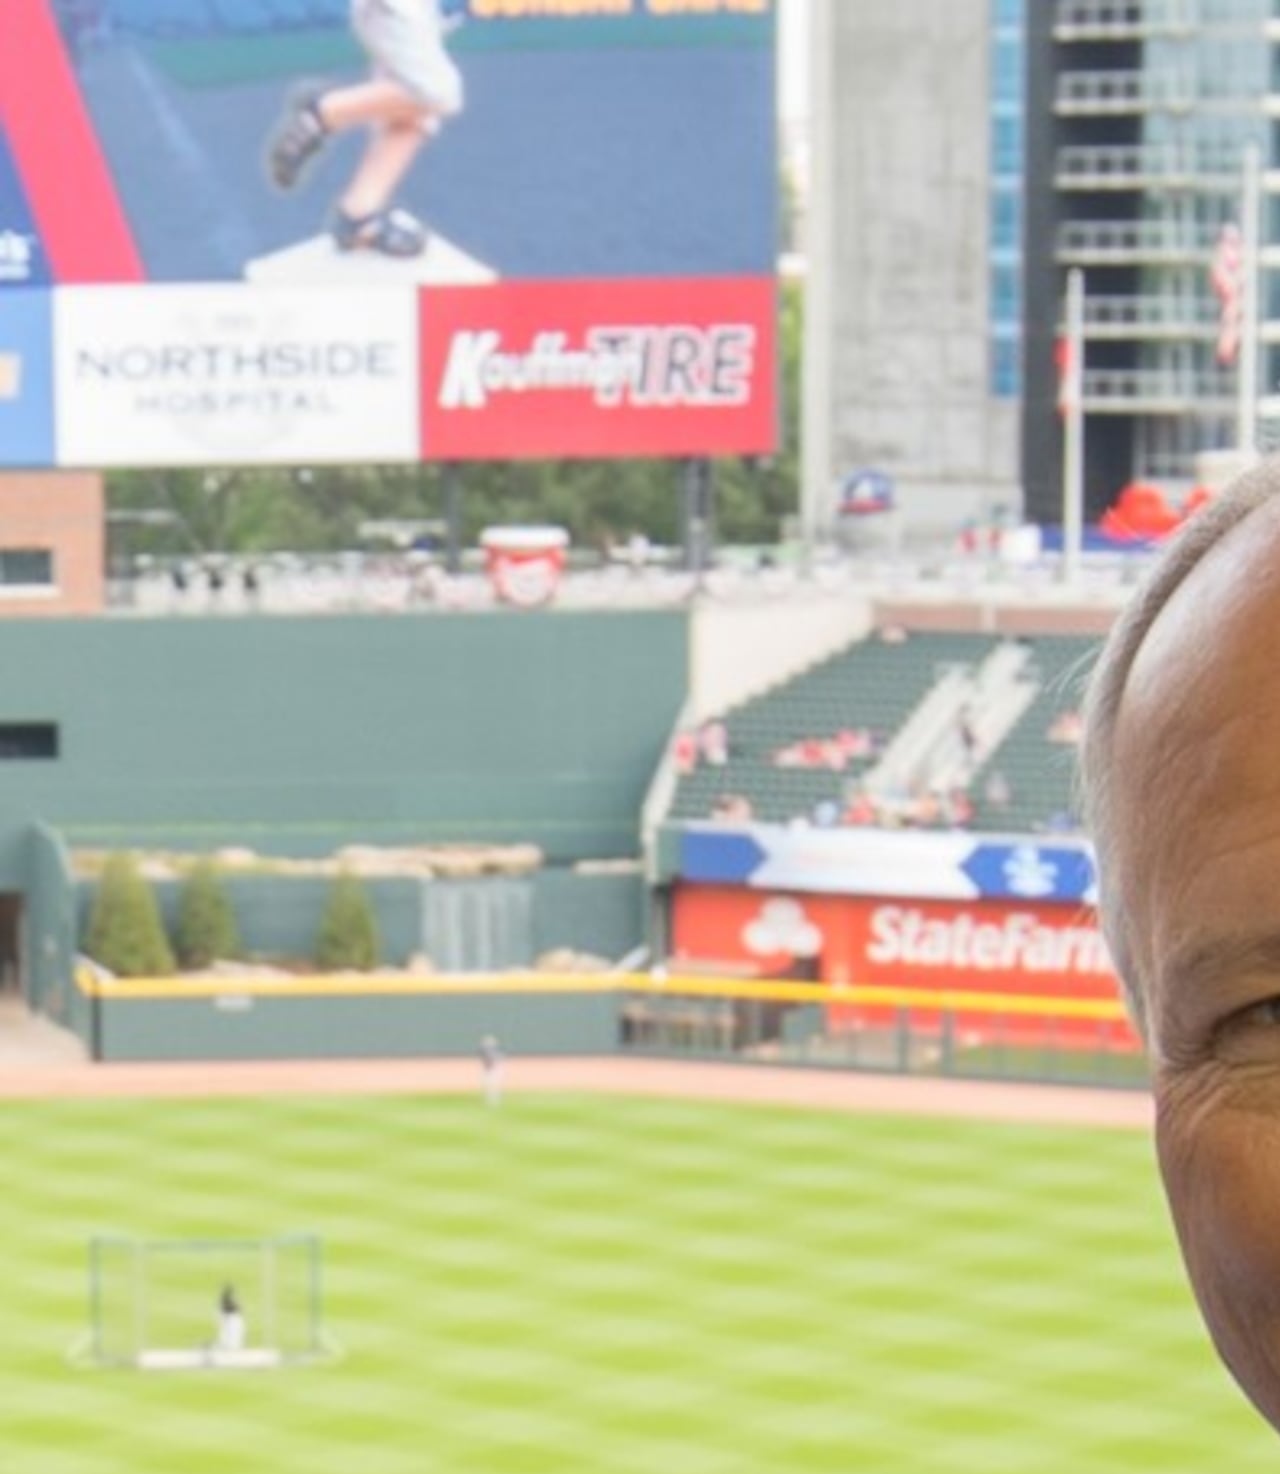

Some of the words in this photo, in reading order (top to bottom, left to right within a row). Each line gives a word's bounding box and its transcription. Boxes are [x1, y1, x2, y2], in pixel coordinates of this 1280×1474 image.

[76, 342, 396, 380] NORTHSIDE
[588, 326, 754, 404] TIRE
[134, 388, 337, 415] HOSPITAL
